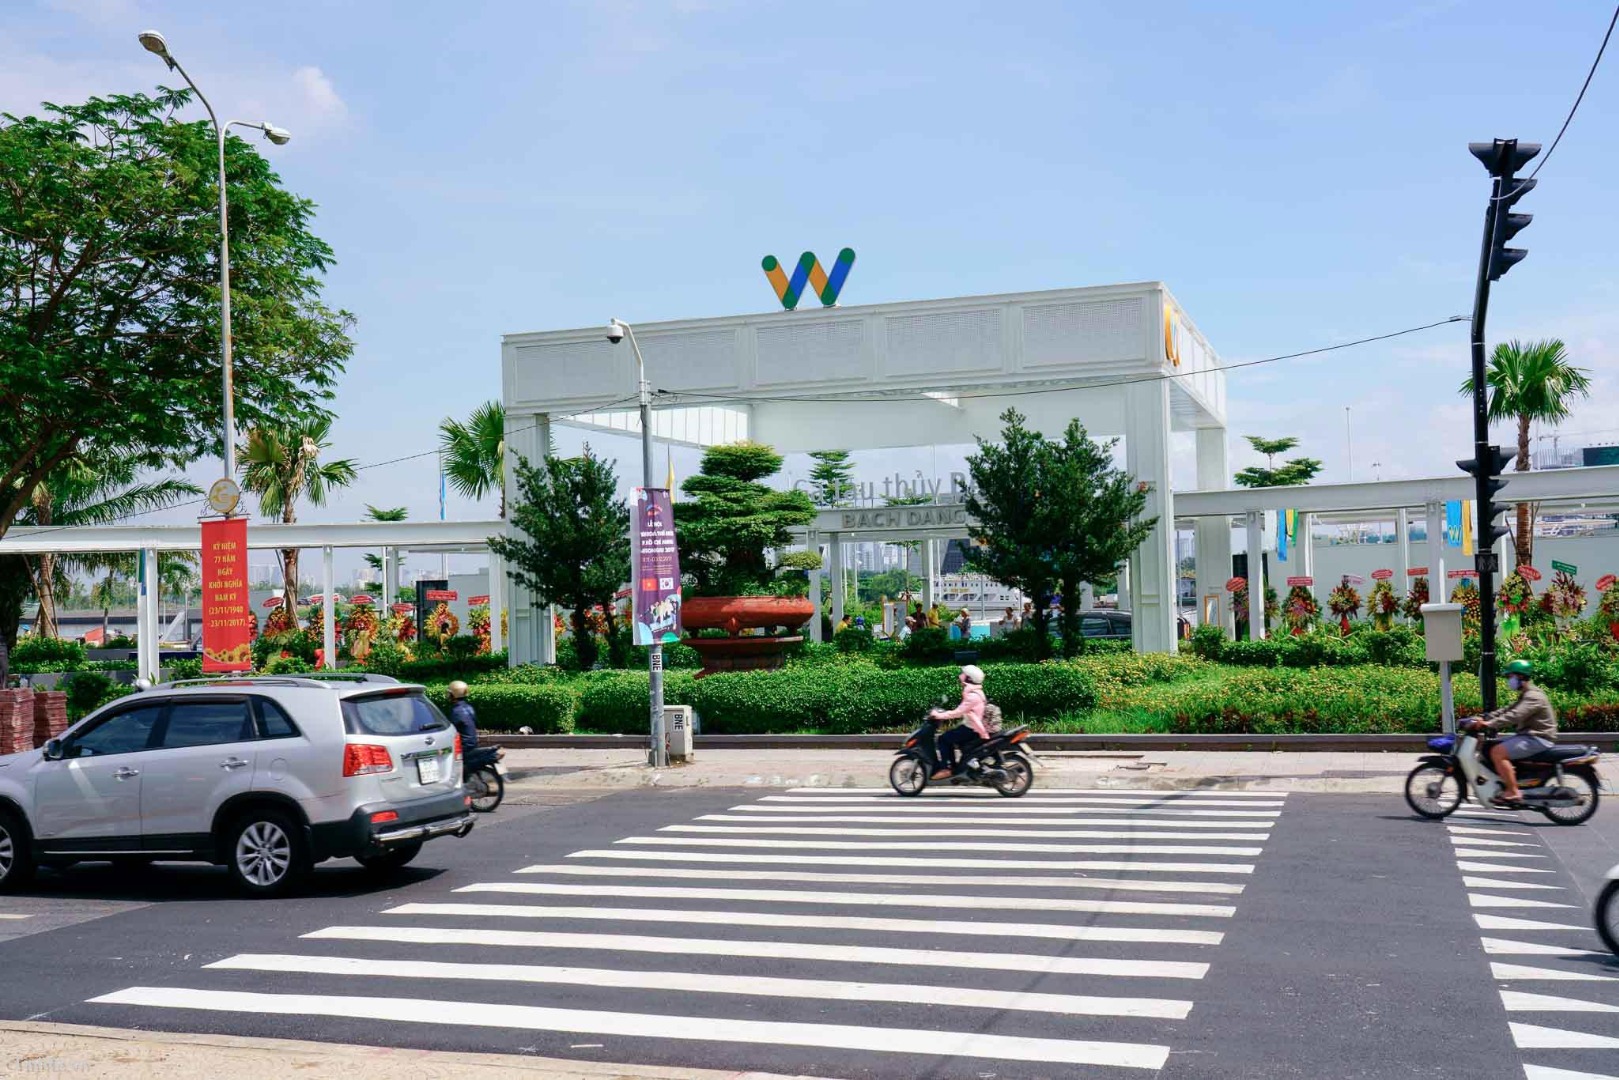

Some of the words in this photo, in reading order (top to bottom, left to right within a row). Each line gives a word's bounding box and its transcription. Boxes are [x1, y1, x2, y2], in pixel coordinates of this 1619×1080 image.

[842, 510, 899, 529] BACH
[907, 509, 966, 526] DANG
[214, 556, 221, 564] 77
[652, 654, 661, 671] BNE
[674, 713, 683, 730] BNE
